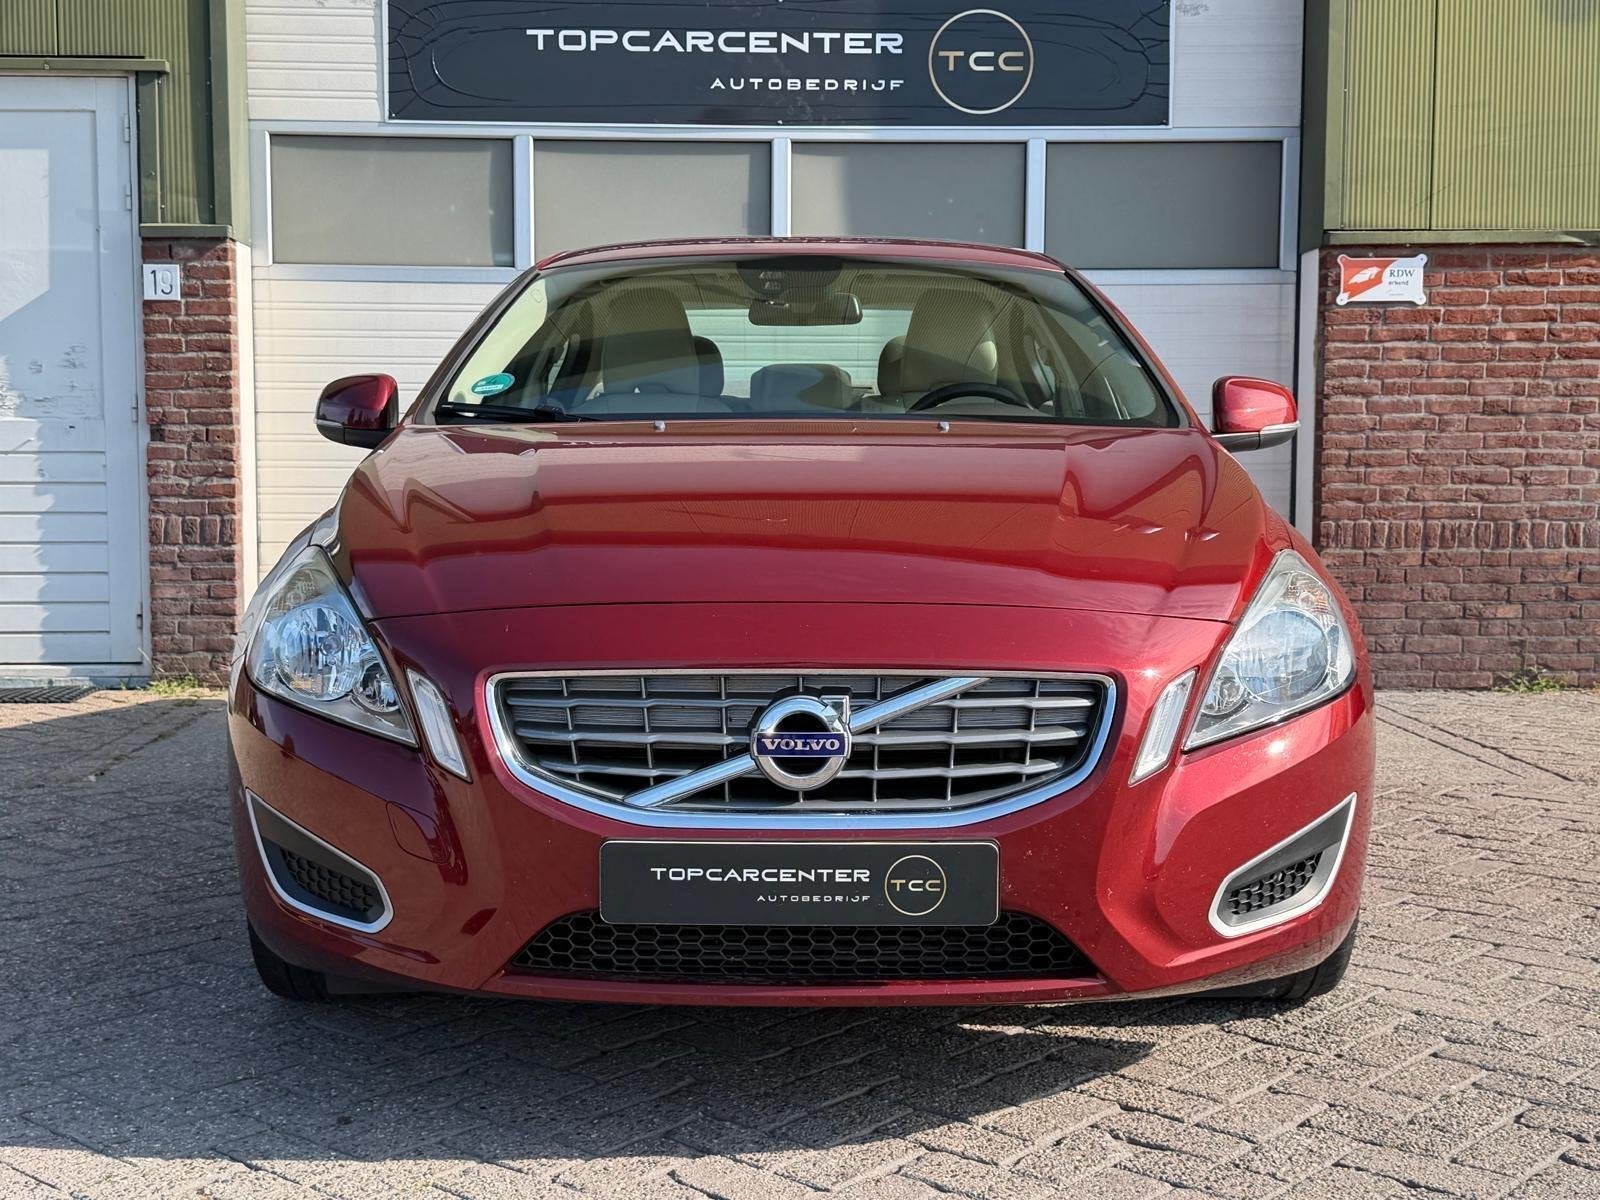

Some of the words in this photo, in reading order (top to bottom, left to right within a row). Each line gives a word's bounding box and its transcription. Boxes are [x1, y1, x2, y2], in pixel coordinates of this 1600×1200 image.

[526, 29, 904, 54] TOPCARCENTER
[937, 50, 1025, 72] TCC
[710, 77, 904, 91] AUTOBEDRIJF
[1389, 269, 1415, 278] RDW
[150, 269, 173, 296] 19
[761, 738, 841, 751] VOLVO
[650, 867, 871, 883] TOPCARCENTER
[890, 879, 941, 892] TCC
[756, 894, 871, 903] AUTOBEDRIJF
